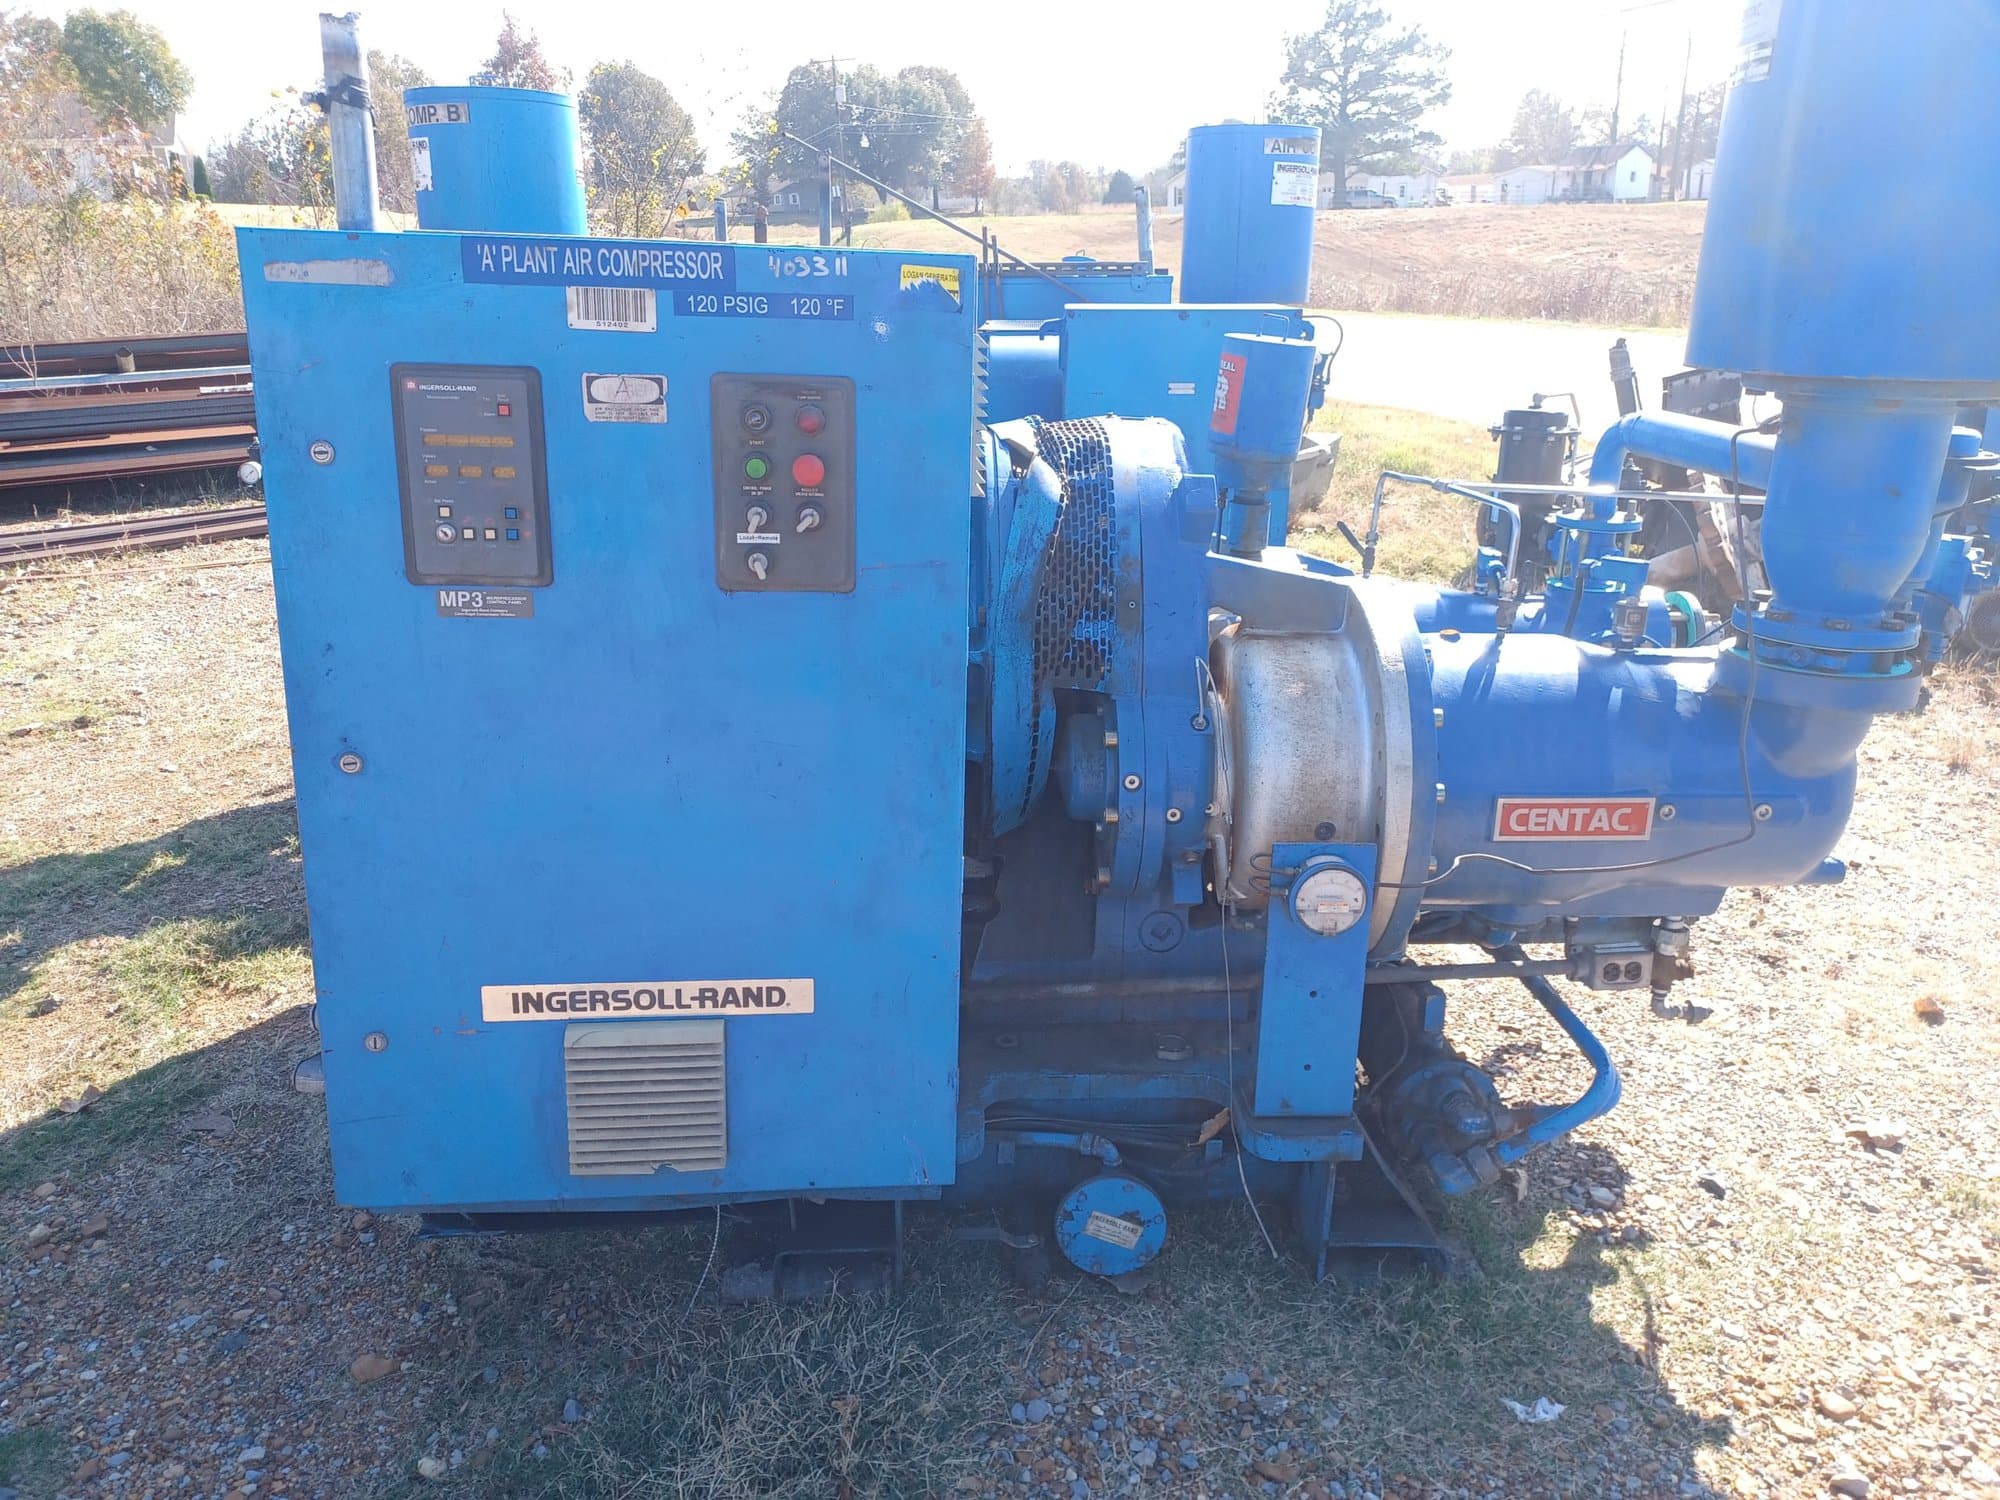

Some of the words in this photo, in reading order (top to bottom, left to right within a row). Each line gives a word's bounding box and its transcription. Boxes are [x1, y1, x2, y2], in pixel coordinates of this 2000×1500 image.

[406, 105, 439, 125] OMP.
[447, 104, 461, 122] B
[501, 244, 558, 274] PLANT
[563, 247, 598, 276] AIR
[597, 247, 724, 280] COMPRESSOR
[768, 255, 848, 278] 403311
[903, 270, 924, 279] LOGAN
[687, 294, 718, 313] 120
[723, 295, 768, 314] PSIG
[791, 297, 821, 316] 120
[826, 298, 845, 316] °F
[419, 384, 477, 392] INGERSOLL-RAND
[439, 590, 483, 608] MP3
[1509, 807, 1632, 832] CENTAC
